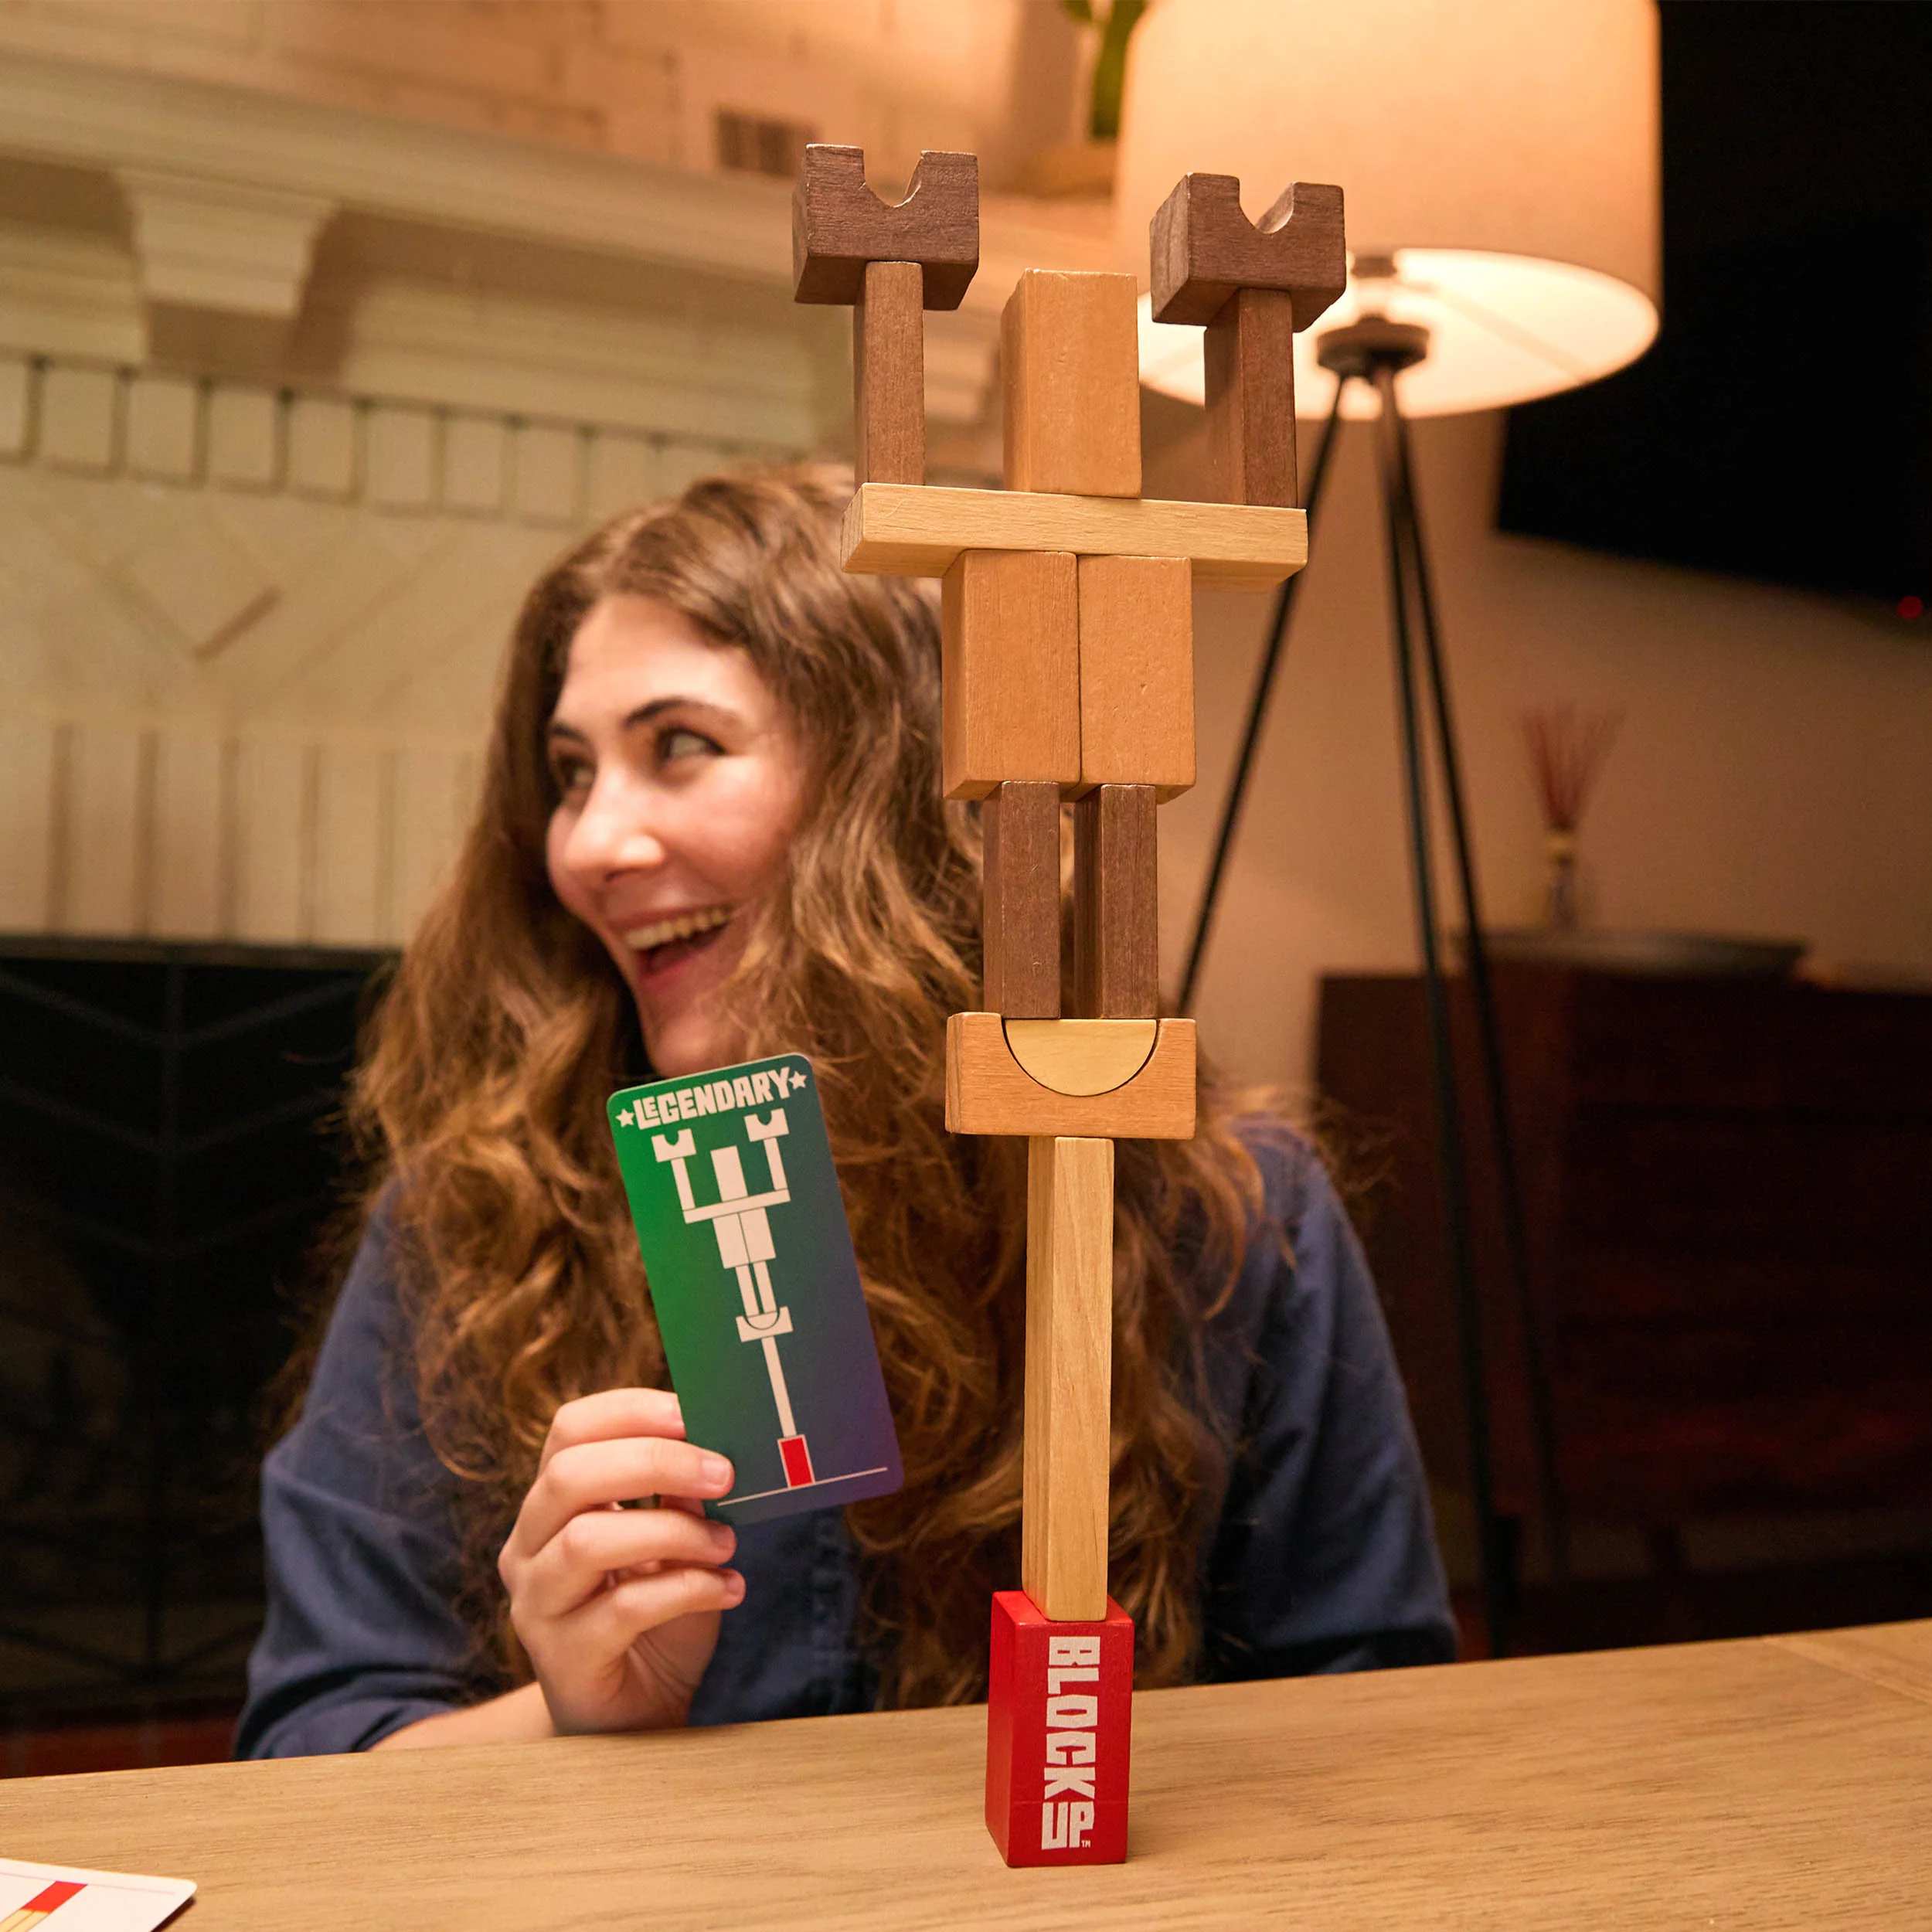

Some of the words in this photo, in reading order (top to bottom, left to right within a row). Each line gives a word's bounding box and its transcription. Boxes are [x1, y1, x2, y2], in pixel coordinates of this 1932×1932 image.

[632, 1066, 791, 1130] LEGENDARY
[1044, 1636, 1100, 1799] BLOCK
[1042, 1801, 1095, 1850] UP
